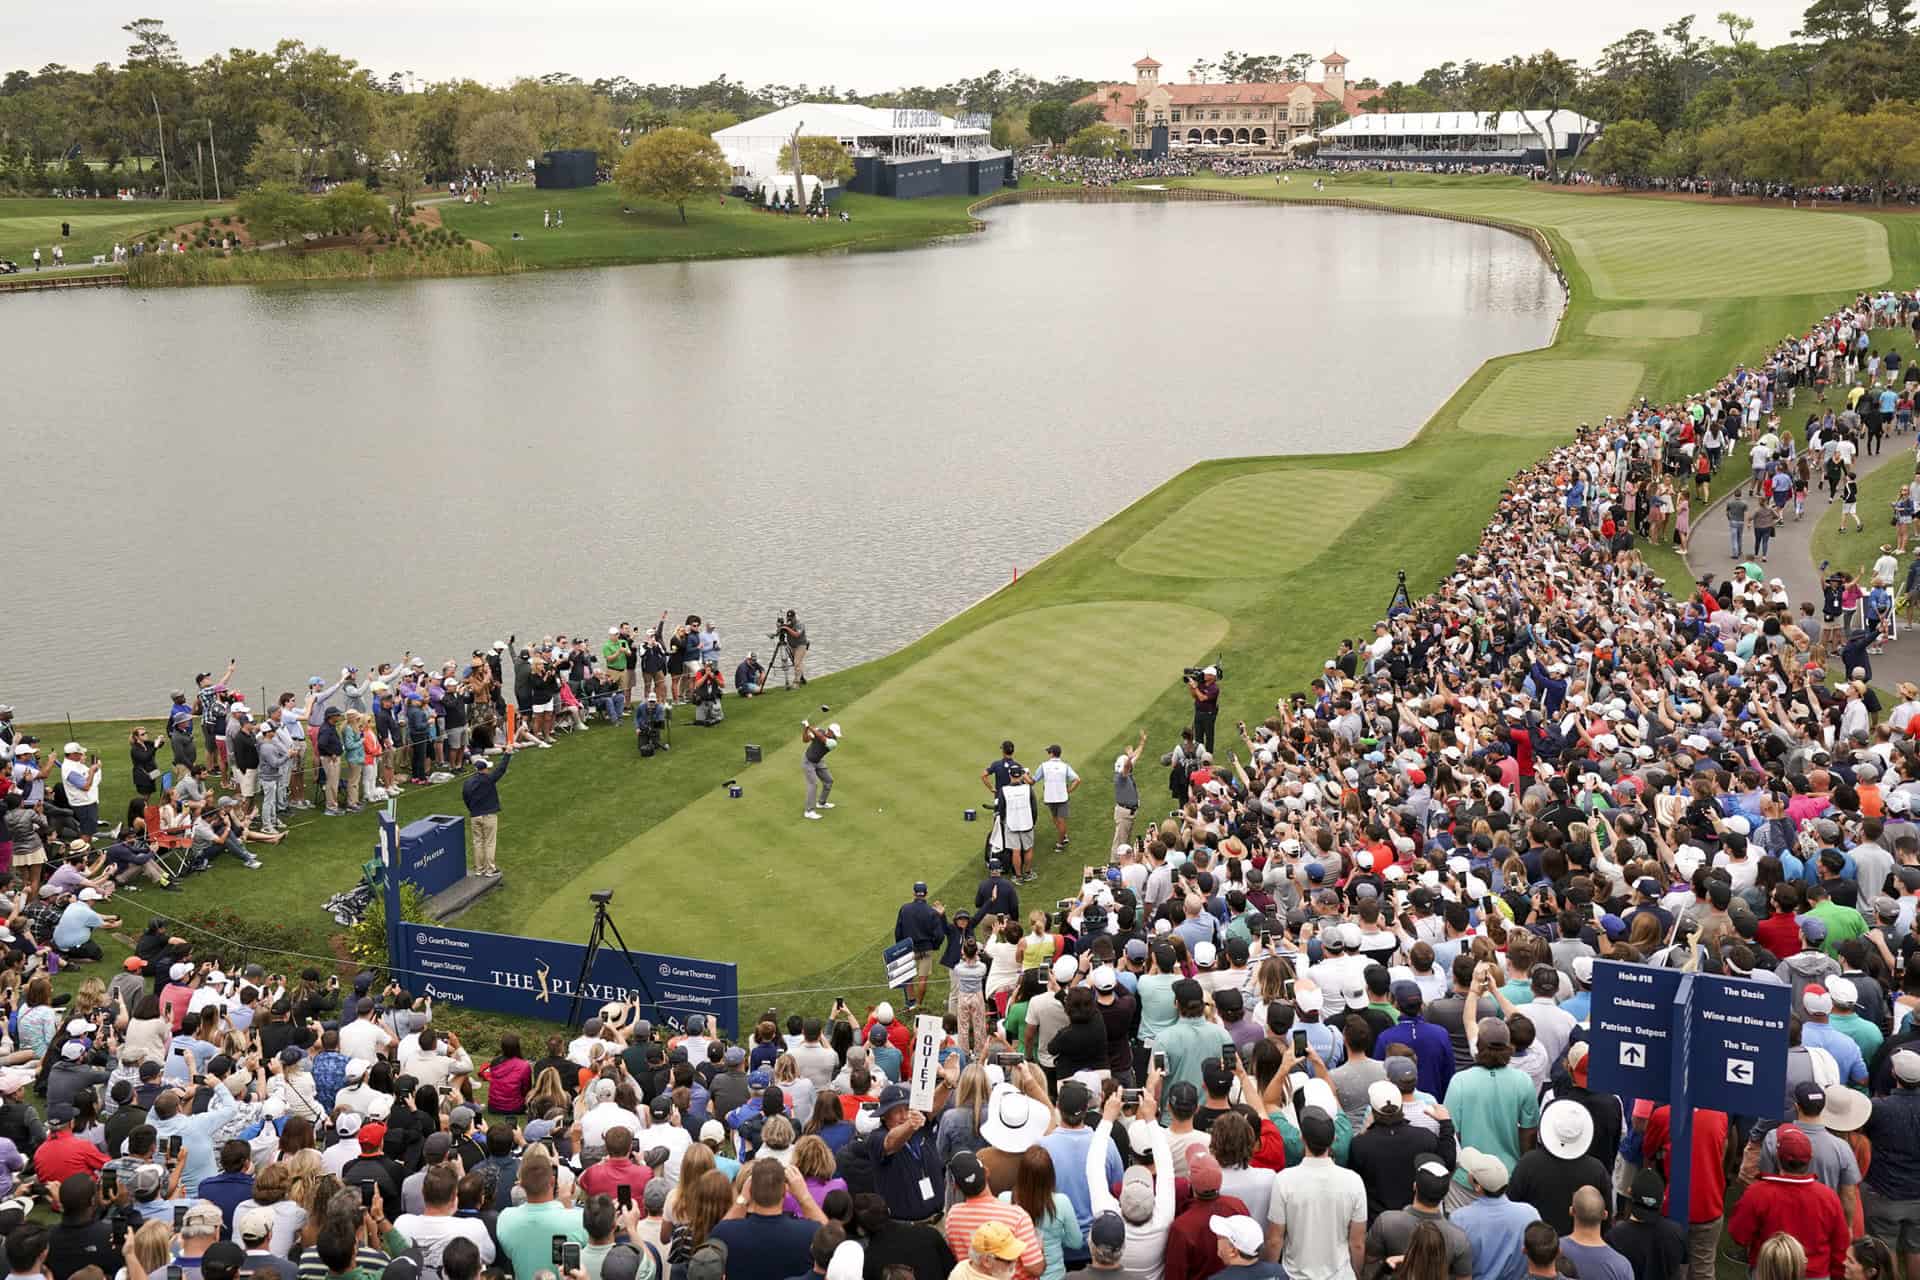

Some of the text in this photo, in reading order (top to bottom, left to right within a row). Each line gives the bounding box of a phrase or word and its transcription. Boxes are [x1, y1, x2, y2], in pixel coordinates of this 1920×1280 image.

[490, 970, 534, 990] THE
[1618, 971, 1637, 982] Hole
[436, 991, 464, 1001] OPTUM
[1723, 986, 1765, 1000] The Oasis
[1613, 996, 1655, 1010] Clubhouse
[1703, 1010, 1725, 1021] Wine
[1726, 1015, 1743, 1024] and
[1744, 1016, 1764, 1027] Dine
[1777, 1020, 1784, 1029] 9
[1600, 1021, 1666, 1038] Patriots Outpost
[1723, 1039, 1760, 1052] The Turn
[920, 1034, 933, 1090] QUIET
